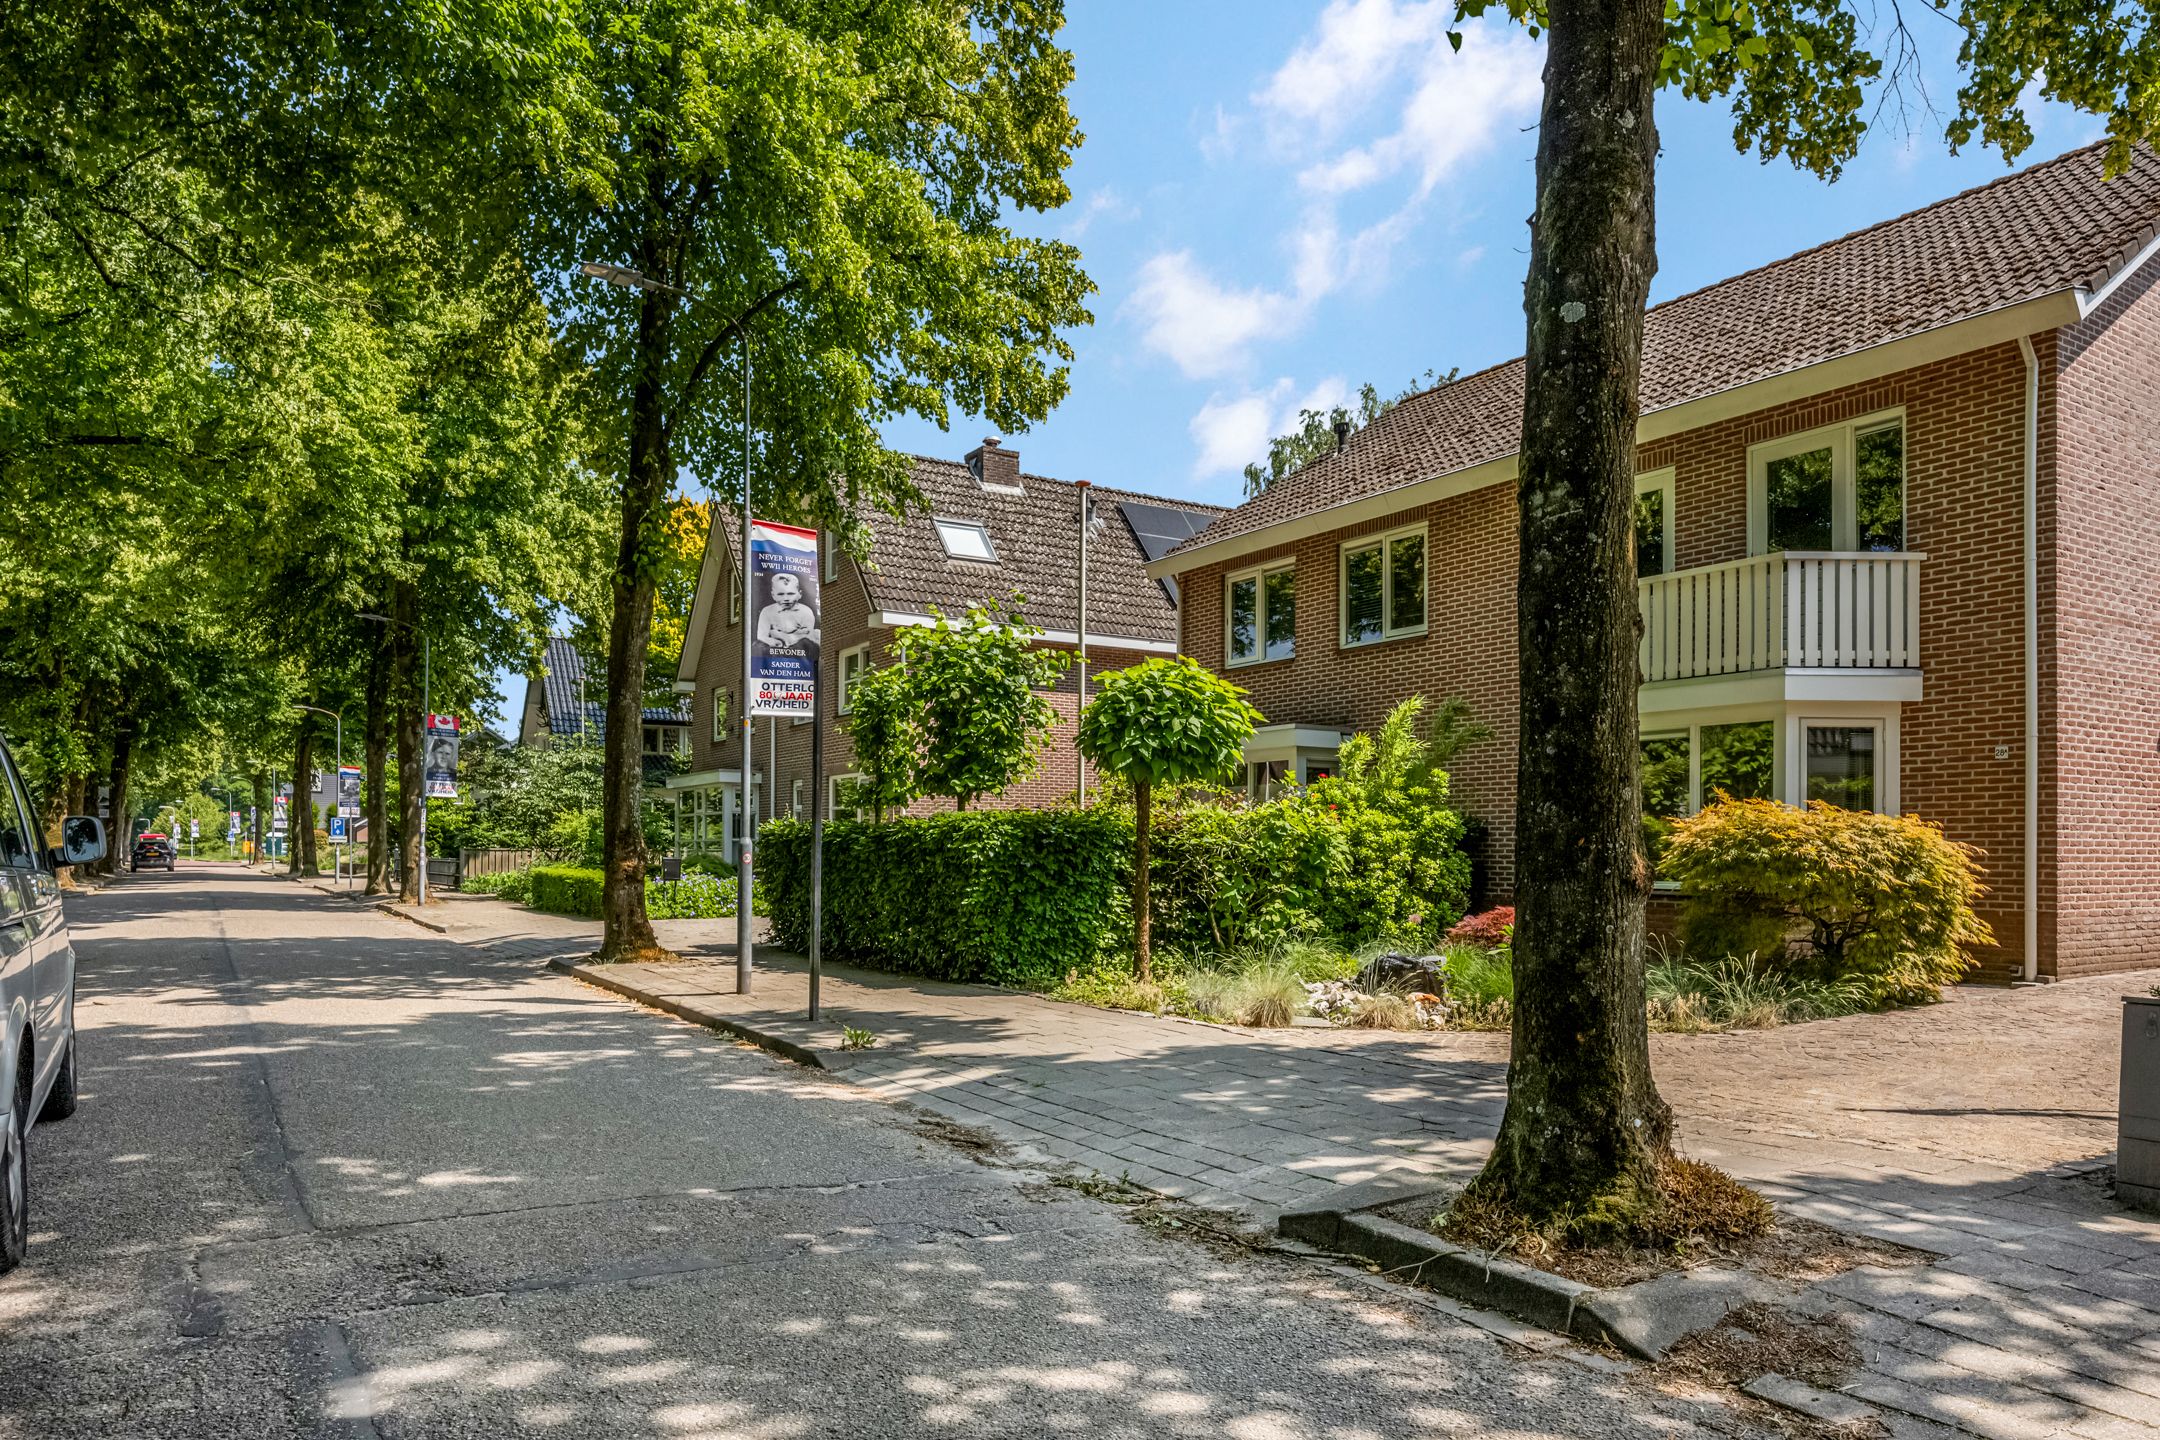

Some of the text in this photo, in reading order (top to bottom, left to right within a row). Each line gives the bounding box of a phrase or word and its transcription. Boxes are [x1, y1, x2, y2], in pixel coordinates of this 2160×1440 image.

[758, 553, 812, 566] NEVER FORGET
[761, 562, 811, 573] WWII HEROES
[769, 648, 806, 656] BEWONER
[759, 691, 813, 700] 80 JAAR
[334, 819, 342, 829] P
